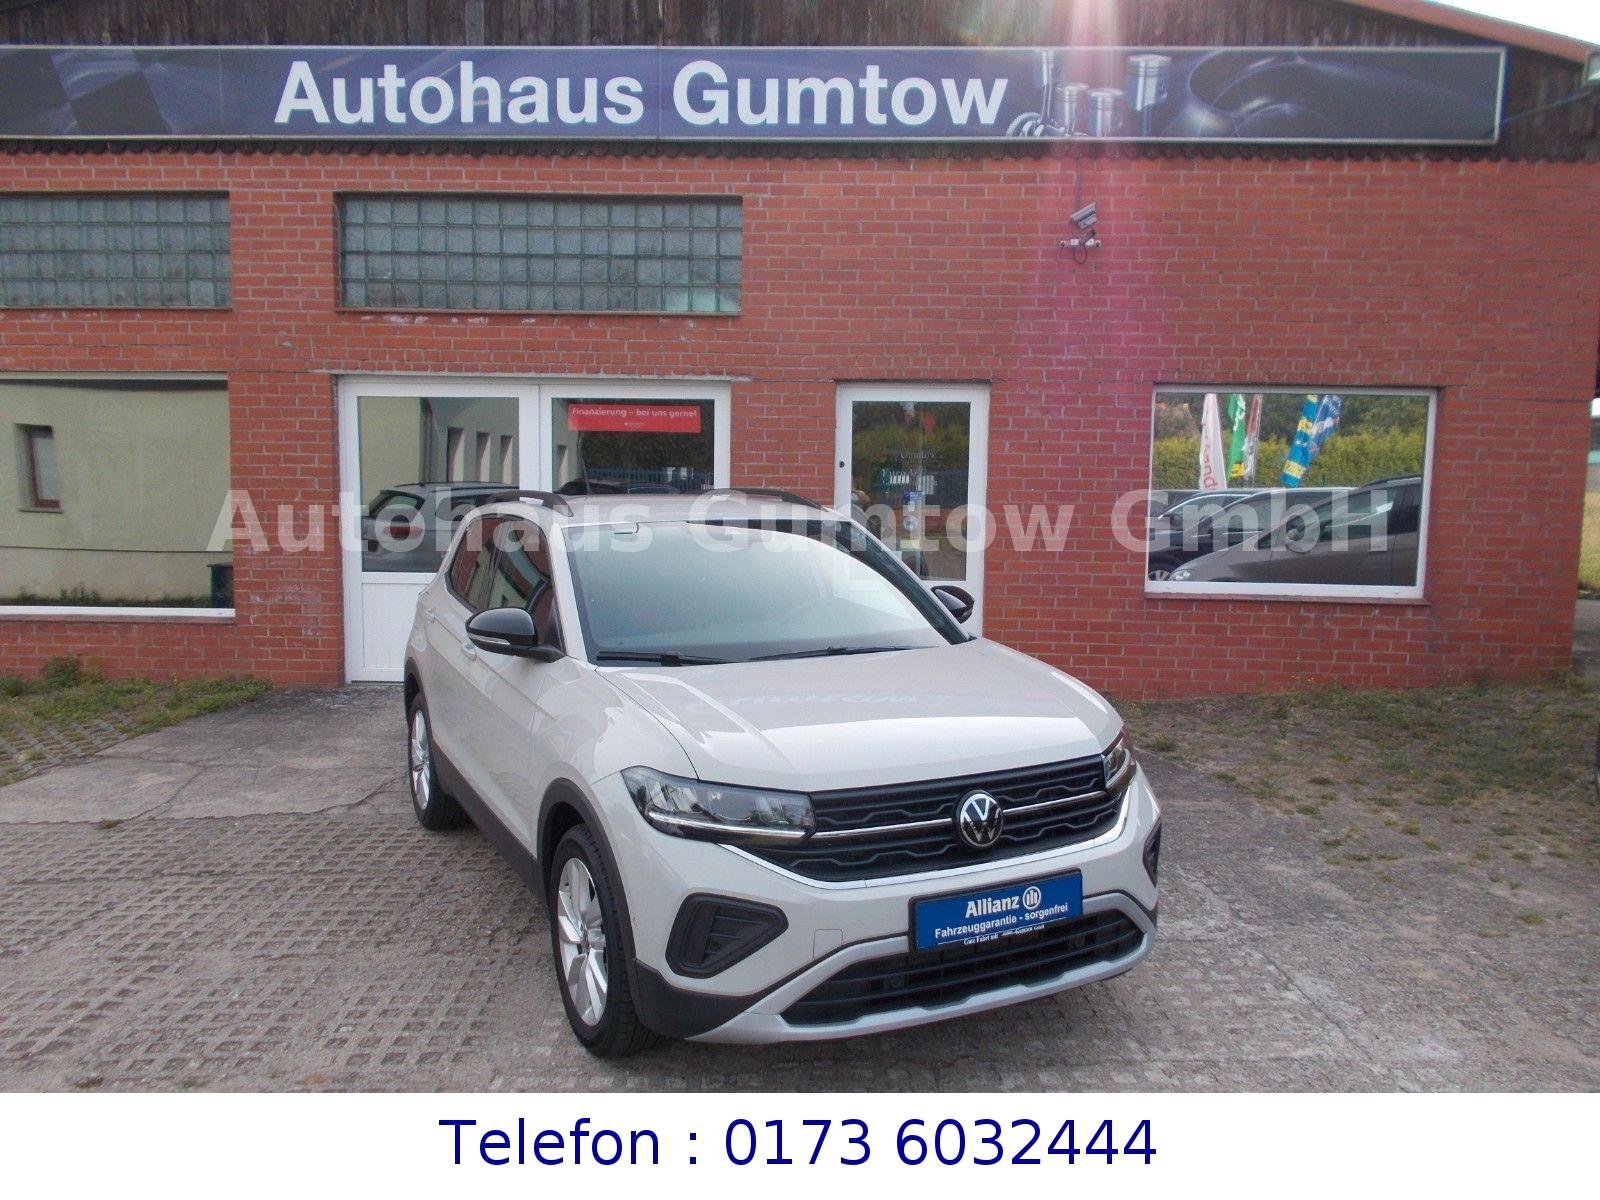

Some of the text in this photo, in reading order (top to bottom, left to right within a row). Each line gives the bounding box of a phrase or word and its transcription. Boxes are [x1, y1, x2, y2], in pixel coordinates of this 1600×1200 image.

[274, 60, 1008, 126] Autohaus Gumtow
[572, 407, 627, 418] Finanzierung
[636, 407, 649, 416] bei
[652, 409, 667, 417] uns
[669, 409, 697, 419] gerne!
[934, 914, 1017, 939] Fahrzeuggarantie
[1024, 902, 1069, 921] sorgenfrei
[965, 895, 1020, 918] Allianz
